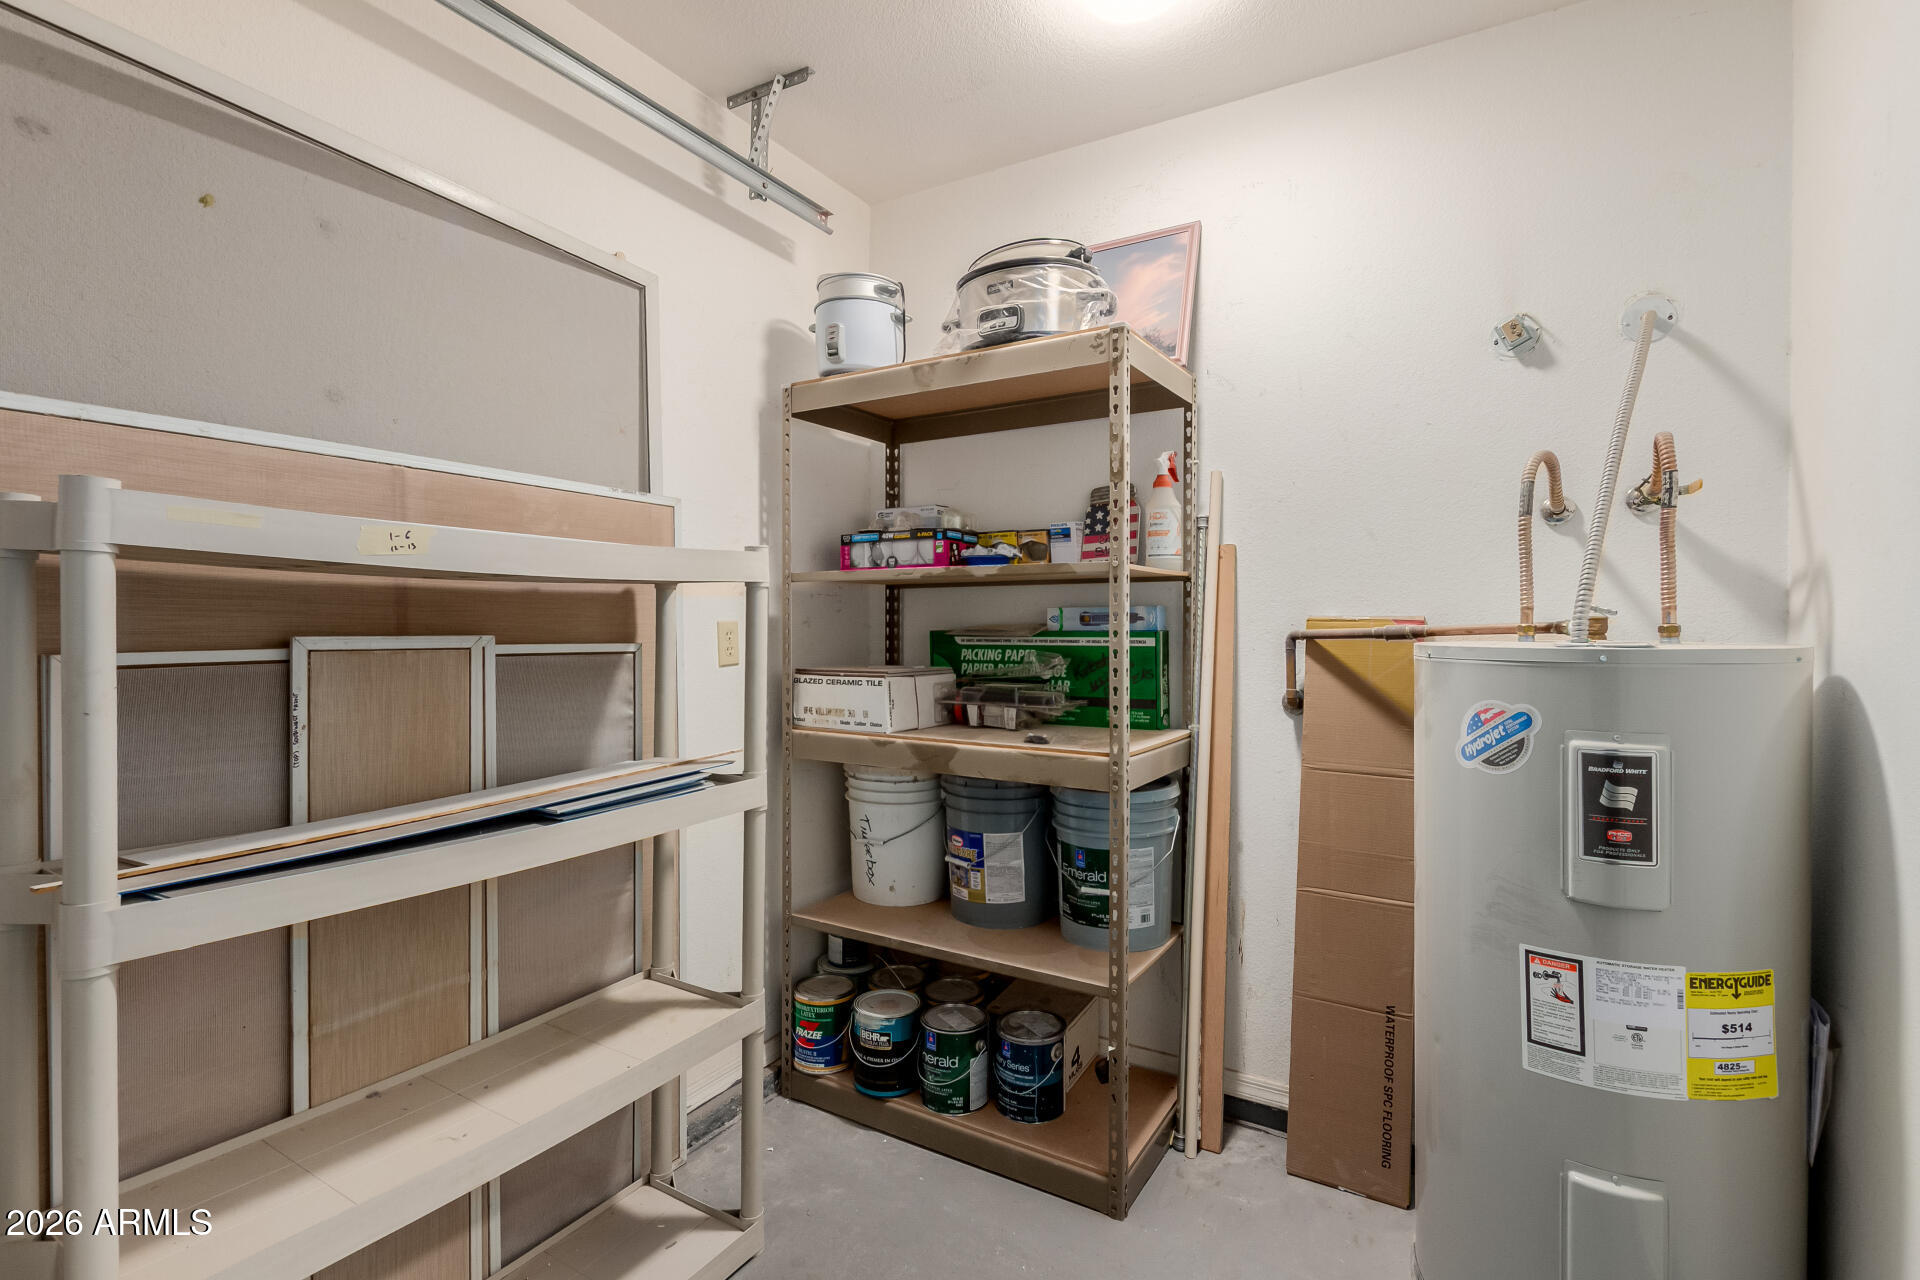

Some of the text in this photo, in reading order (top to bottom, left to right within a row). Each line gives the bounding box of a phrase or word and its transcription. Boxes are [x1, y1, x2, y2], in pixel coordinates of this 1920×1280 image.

[960, 649, 1037, 662] PACKING PAPER
[793, 677, 883, 687] GLAZED CERAMIC TILE
[1464, 724, 1506, 757] Hydrojet
[1588, 766, 1624, 774] BRADFORD
[1062, 862, 1107, 882] Emerald
[1542, 960, 1571, 969] DANGER
[1689, 974, 1772, 990] ENERGYGUIDE
[796, 1026, 823, 1040] FRAZEE
[1721, 1022, 1753, 1035] $514
[861, 1029, 880, 1042] BEHR
[1071, 1045, 1081, 1068] 4
[1007, 1059, 1030, 1073] Series
[1717, 1062, 1741, 1071] 4825
[1381, 1005, 1396, 1169] WATERPROOF SPC FLOORING
